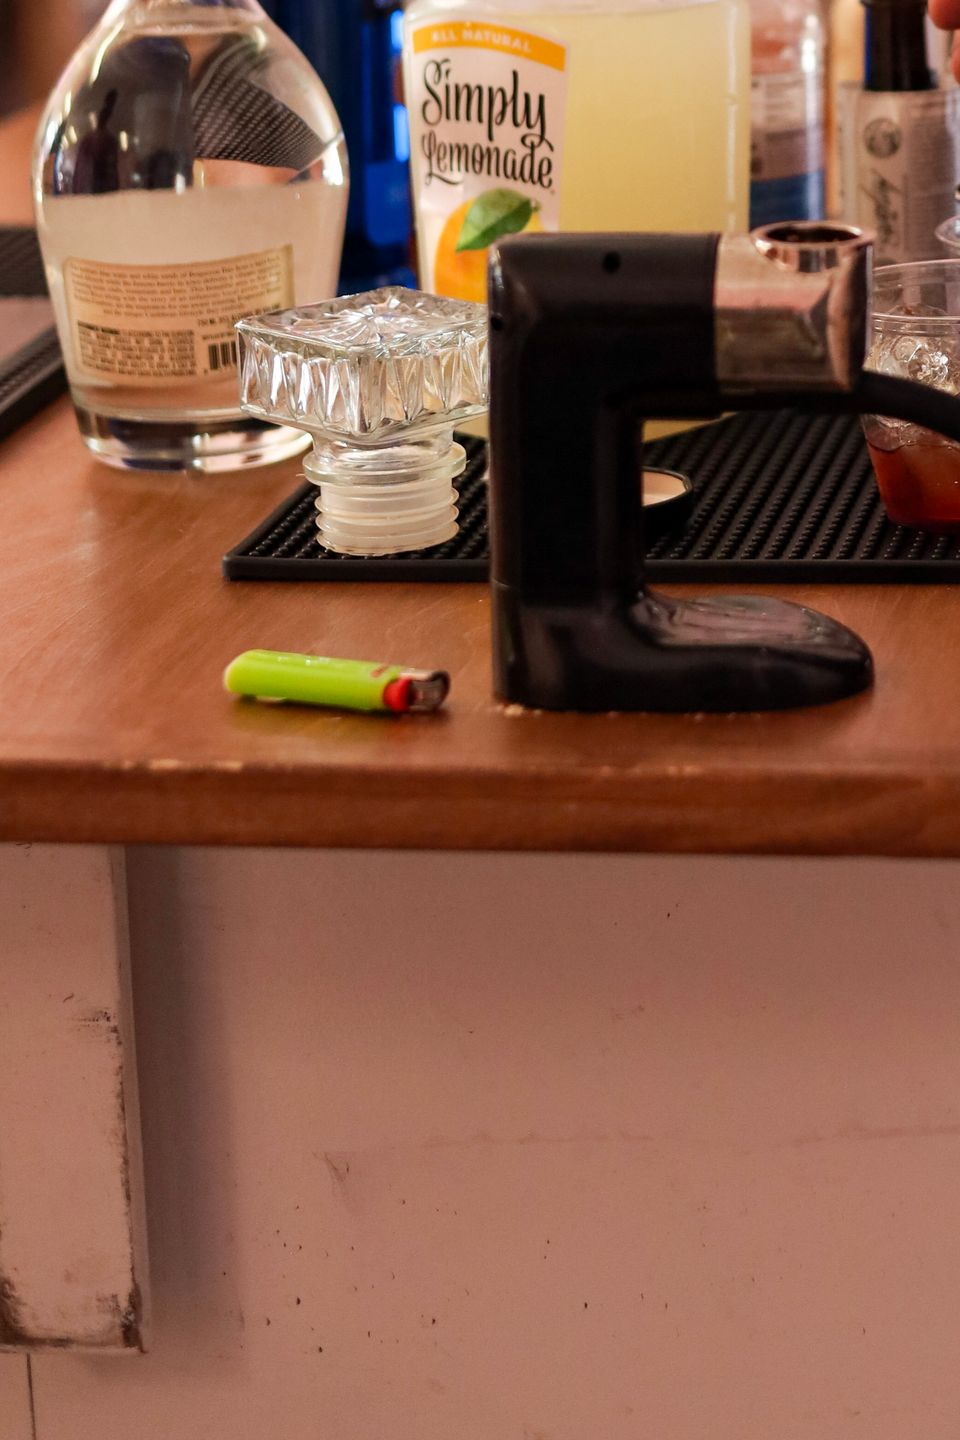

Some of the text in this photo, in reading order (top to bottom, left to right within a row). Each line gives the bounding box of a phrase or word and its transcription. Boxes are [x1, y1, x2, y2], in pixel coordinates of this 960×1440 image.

[432, 28, 532, 52] ALL NATURAL
[421, 57, 554, 154] Simply
[421, 130, 553, 189] Lemonade
